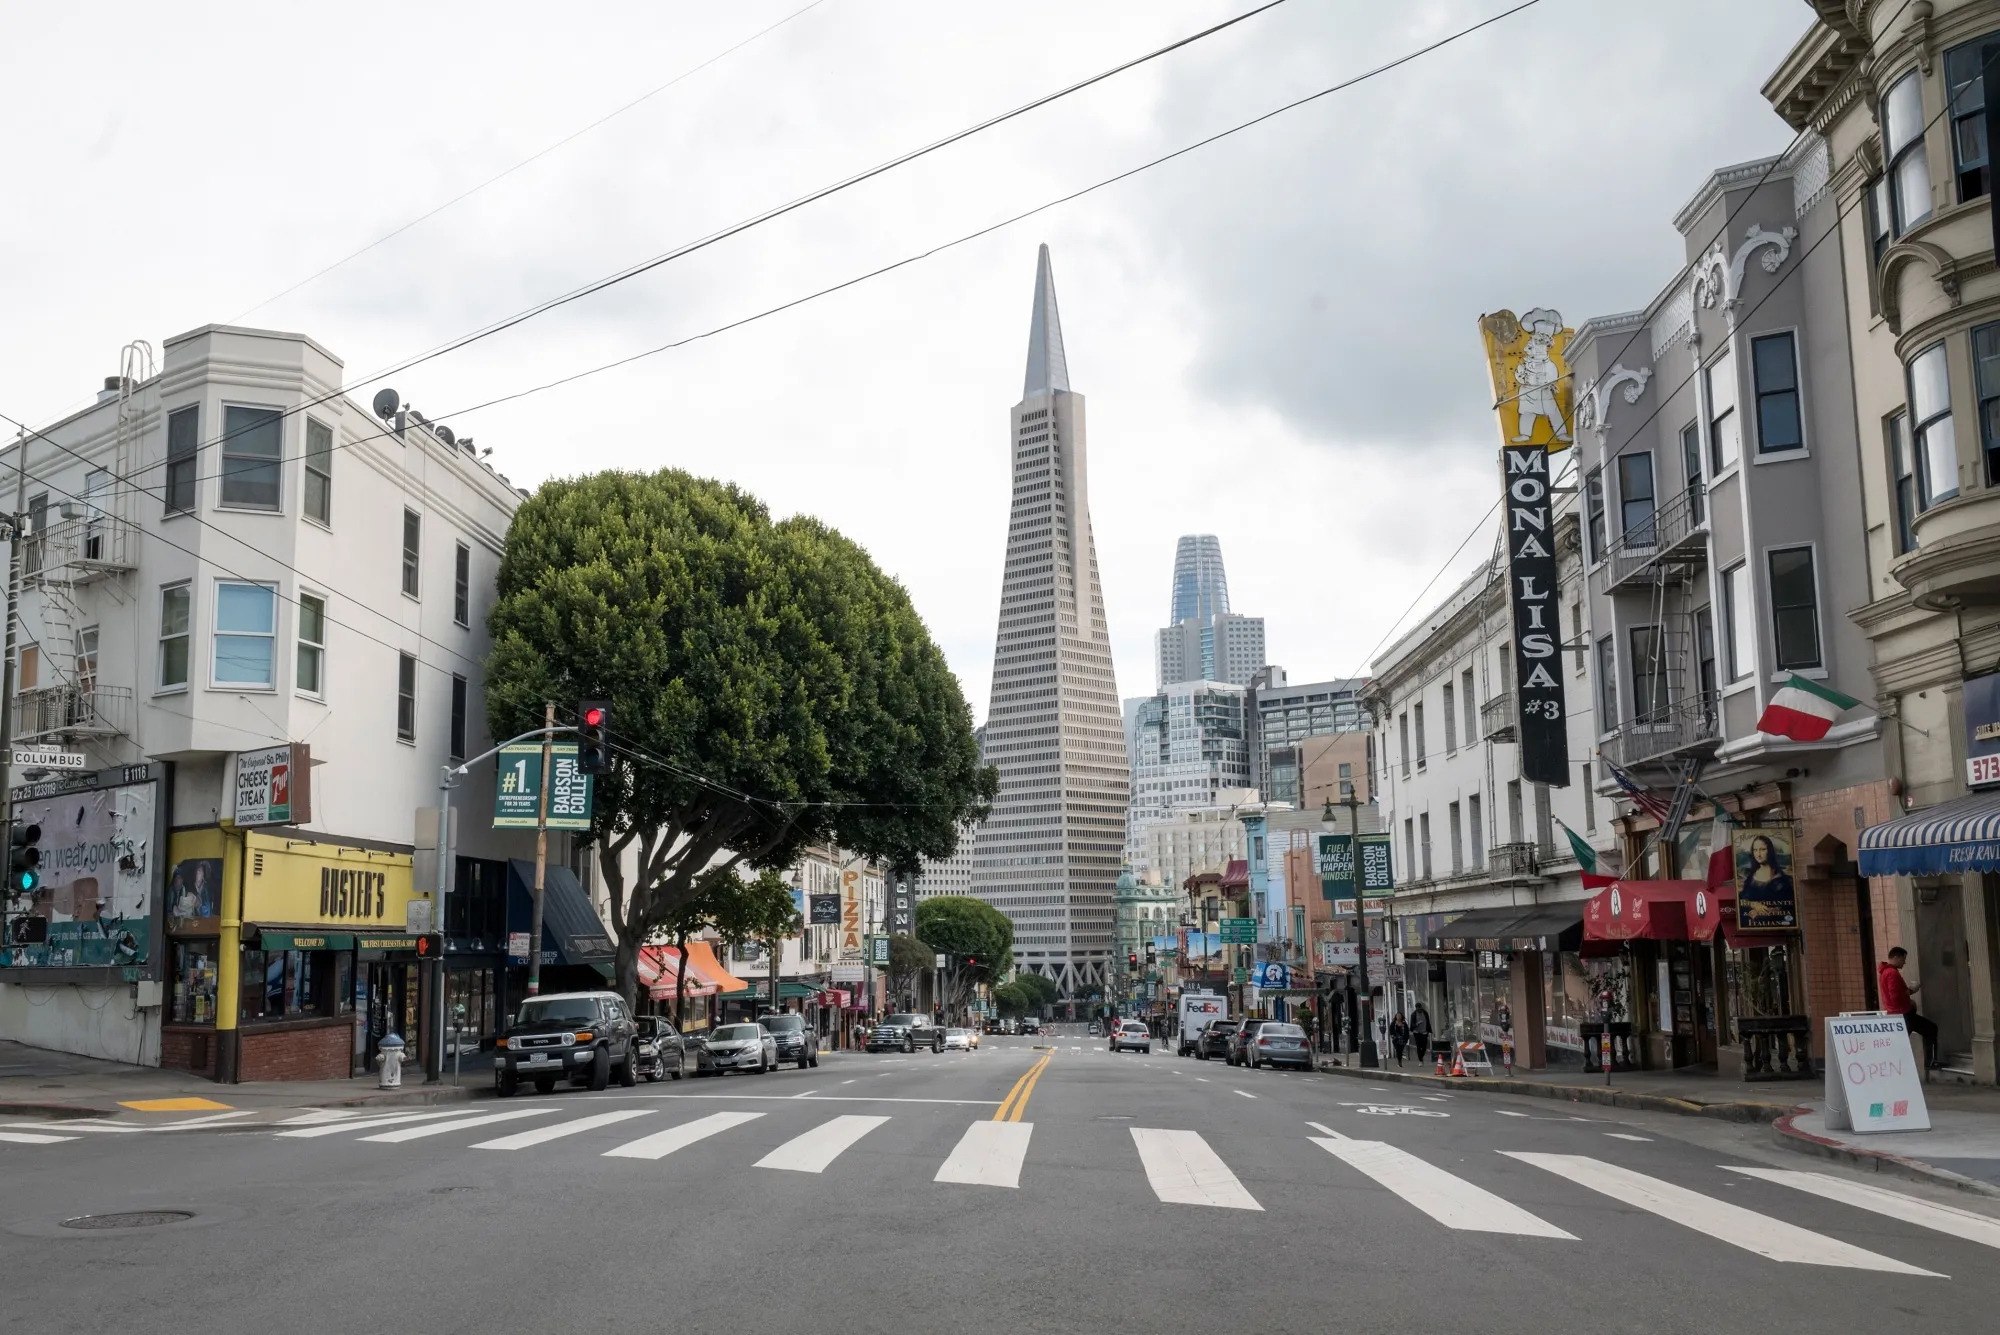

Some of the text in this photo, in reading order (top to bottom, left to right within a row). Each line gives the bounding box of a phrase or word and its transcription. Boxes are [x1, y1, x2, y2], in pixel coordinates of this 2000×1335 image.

[1507, 450, 1559, 688] MONA LISA
[1524, 698, 1560, 721] #3
[15, 753, 82, 766] COLUMBUS
[275, 751, 289, 764] Philly
[131, 767, 147, 780] 1116
[502, 759, 526, 793] #1
[1973, 756, 2000, 781] 373
[238, 769, 268, 788] CHEESE
[272, 770, 288, 803] 7UP
[553, 758, 573, 814] BABSON
[240, 789, 265, 806] STEAK
[238, 813, 264, 822] SANDWICHES
[56, 847, 85, 868] wear
[90, 840, 134, 872] gowns
[1326, 843, 1352, 853] FUEL A
[1949, 845, 1976, 863] FRESH
[1322, 862, 1353, 872] HAPPEN
[1363, 845, 1377, 887] BABSON
[1375, 845, 1389, 886] COLLEGE
[1321, 871, 1353, 881] MINDSET
[320, 866, 385, 919] BUSTER'S
[843, 871, 859, 948] PIZZA
[294, 938, 318, 946] WELCOME
[361, 940, 369, 948] THE
[369, 940, 380, 948] FIRST
[405, 940, 416, 948] SHOP
[1187, 1002, 1219, 1013] FedEx
[1833, 1022, 1904, 1035] MOLINARI'S
